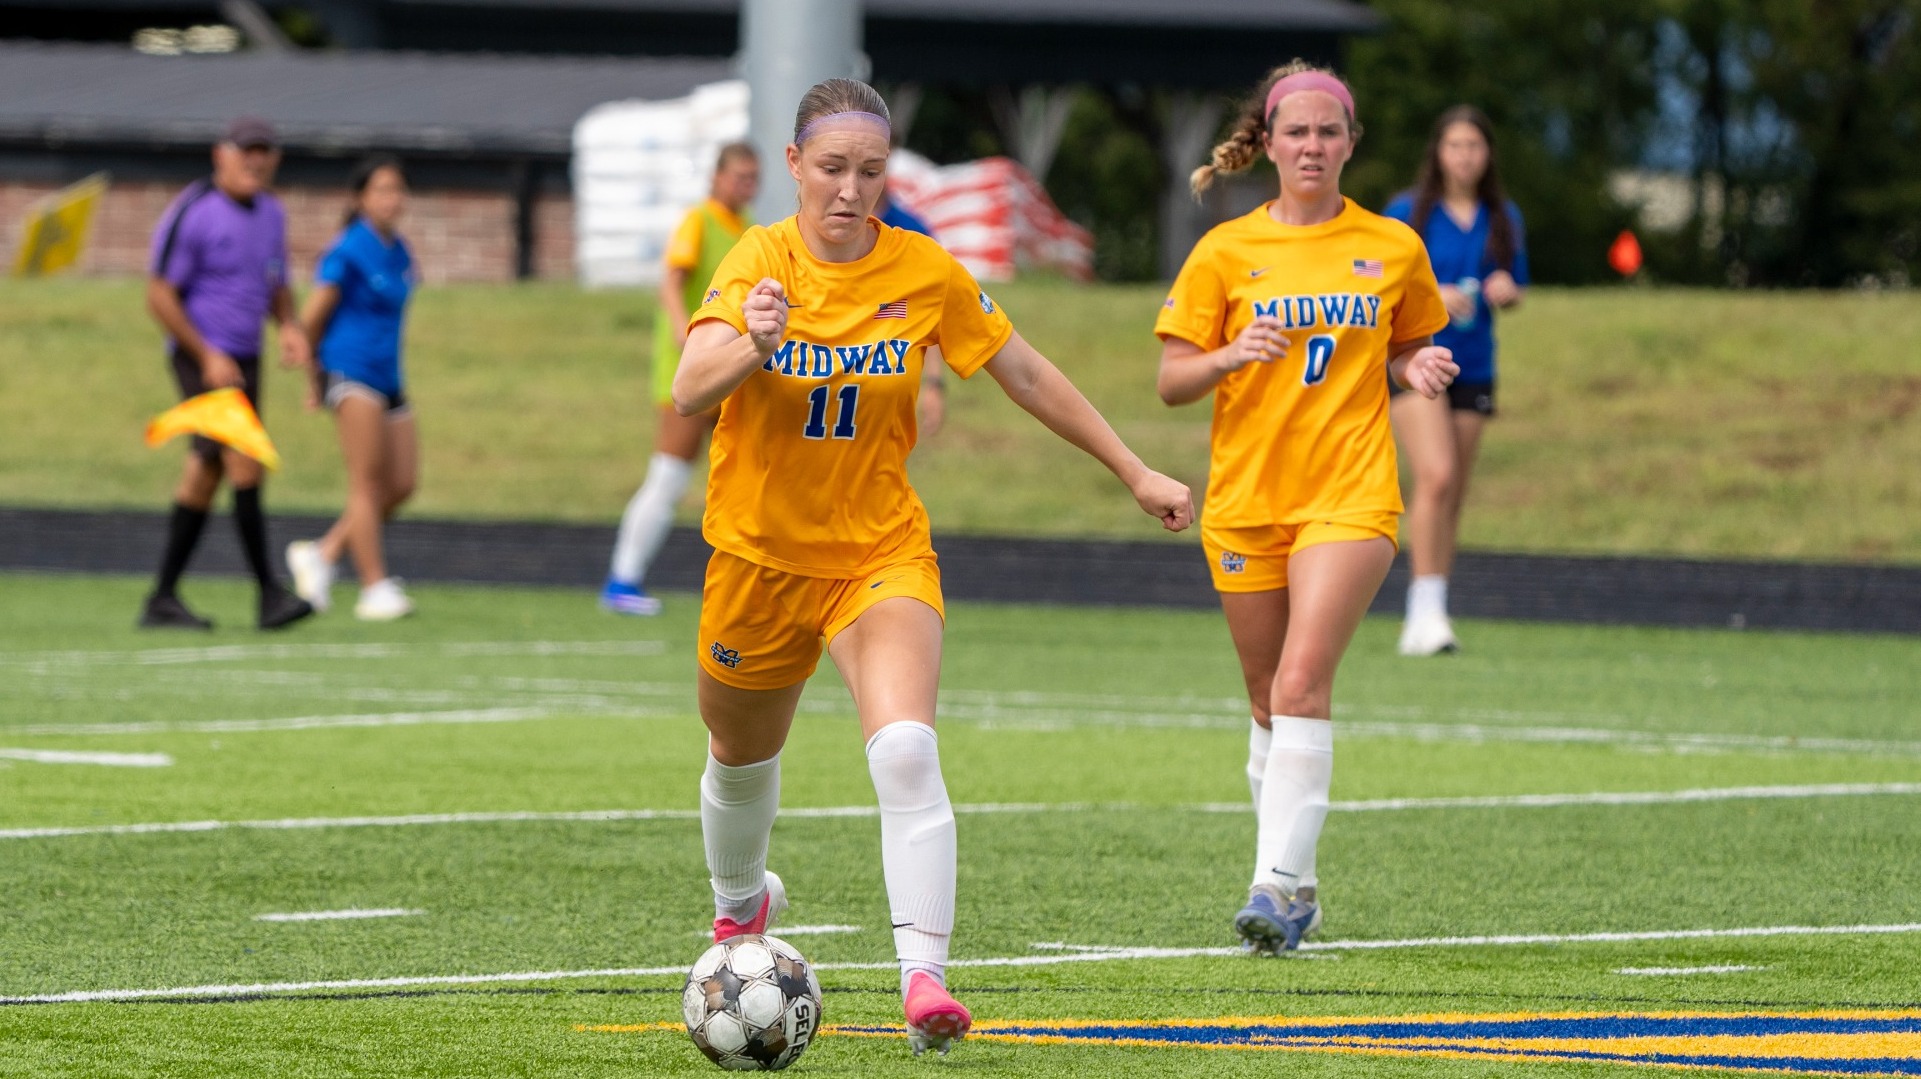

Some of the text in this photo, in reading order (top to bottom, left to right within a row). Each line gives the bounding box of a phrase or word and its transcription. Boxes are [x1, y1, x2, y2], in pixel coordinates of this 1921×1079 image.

[1253, 295, 1381, 329] MIDWAY
[762, 339, 911, 378] MIDWAY
[1303, 336, 1336, 386] 0
[802, 384, 861, 440] 11
